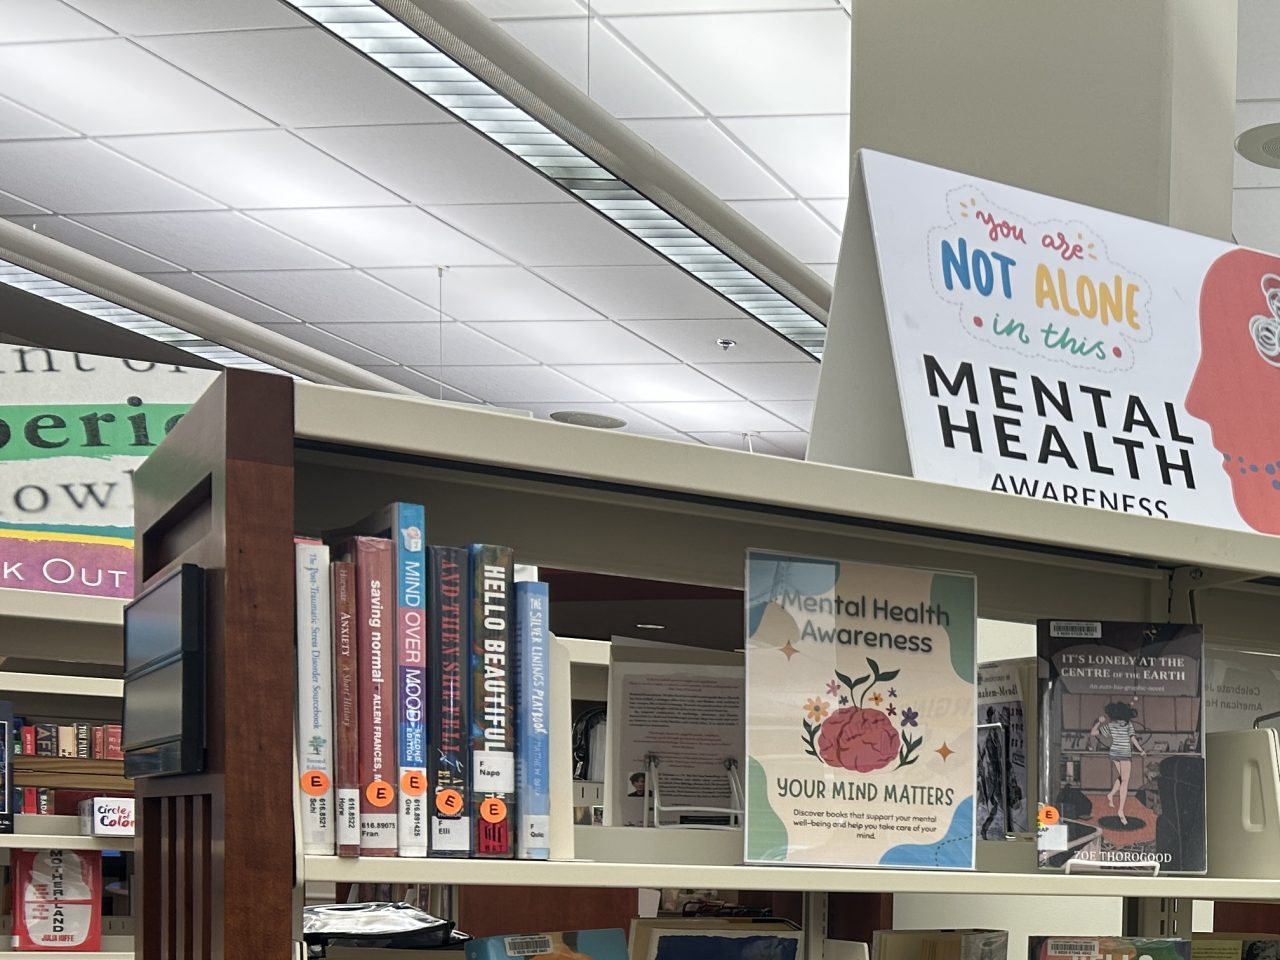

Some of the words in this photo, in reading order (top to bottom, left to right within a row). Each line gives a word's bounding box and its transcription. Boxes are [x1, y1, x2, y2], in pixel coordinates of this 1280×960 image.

[976, 210, 1027, 245] you
[1041, 232, 1084, 260] are
[941, 237, 1017, 299] NOT
[1035, 263, 1141, 330] ALONE
[993, 313, 1029, 344] in
[1041, 323, 1106, 360] this
[923, 354, 1194, 445] MENTAL
[937, 404, 1196, 490] HEALTH
[368, 580, 381, 628] saving
[406, 560, 420, 608] MIND
[483, 565, 506, 631] HELLO
[781, 589, 867, 617] Mental
[873, 597, 950, 627] Health
[341, 611, 350, 657] ANXIETY
[371, 632, 383, 683] normal
[404, 612, 420, 663] OVER
[800, 621, 933, 654] Awareness
[1061, 653, 1085, 664] IT'S
[1088, 655, 1136, 667] LONELY
[1138, 656, 1155, 667] AT
[1158, 657, 1185, 668] THE
[405, 668, 421, 722] MOOD
[483, 639, 506, 752] BEAUTIFUL
[777, 778, 825, 798] YOUR
[832, 781, 878, 801] MIND
[885, 785, 954, 806] MATTERS
[793, 809, 824, 817] Discover
[826, 810, 848, 818] books
[866, 813, 894, 821] support
[848, 822, 863, 830] help
